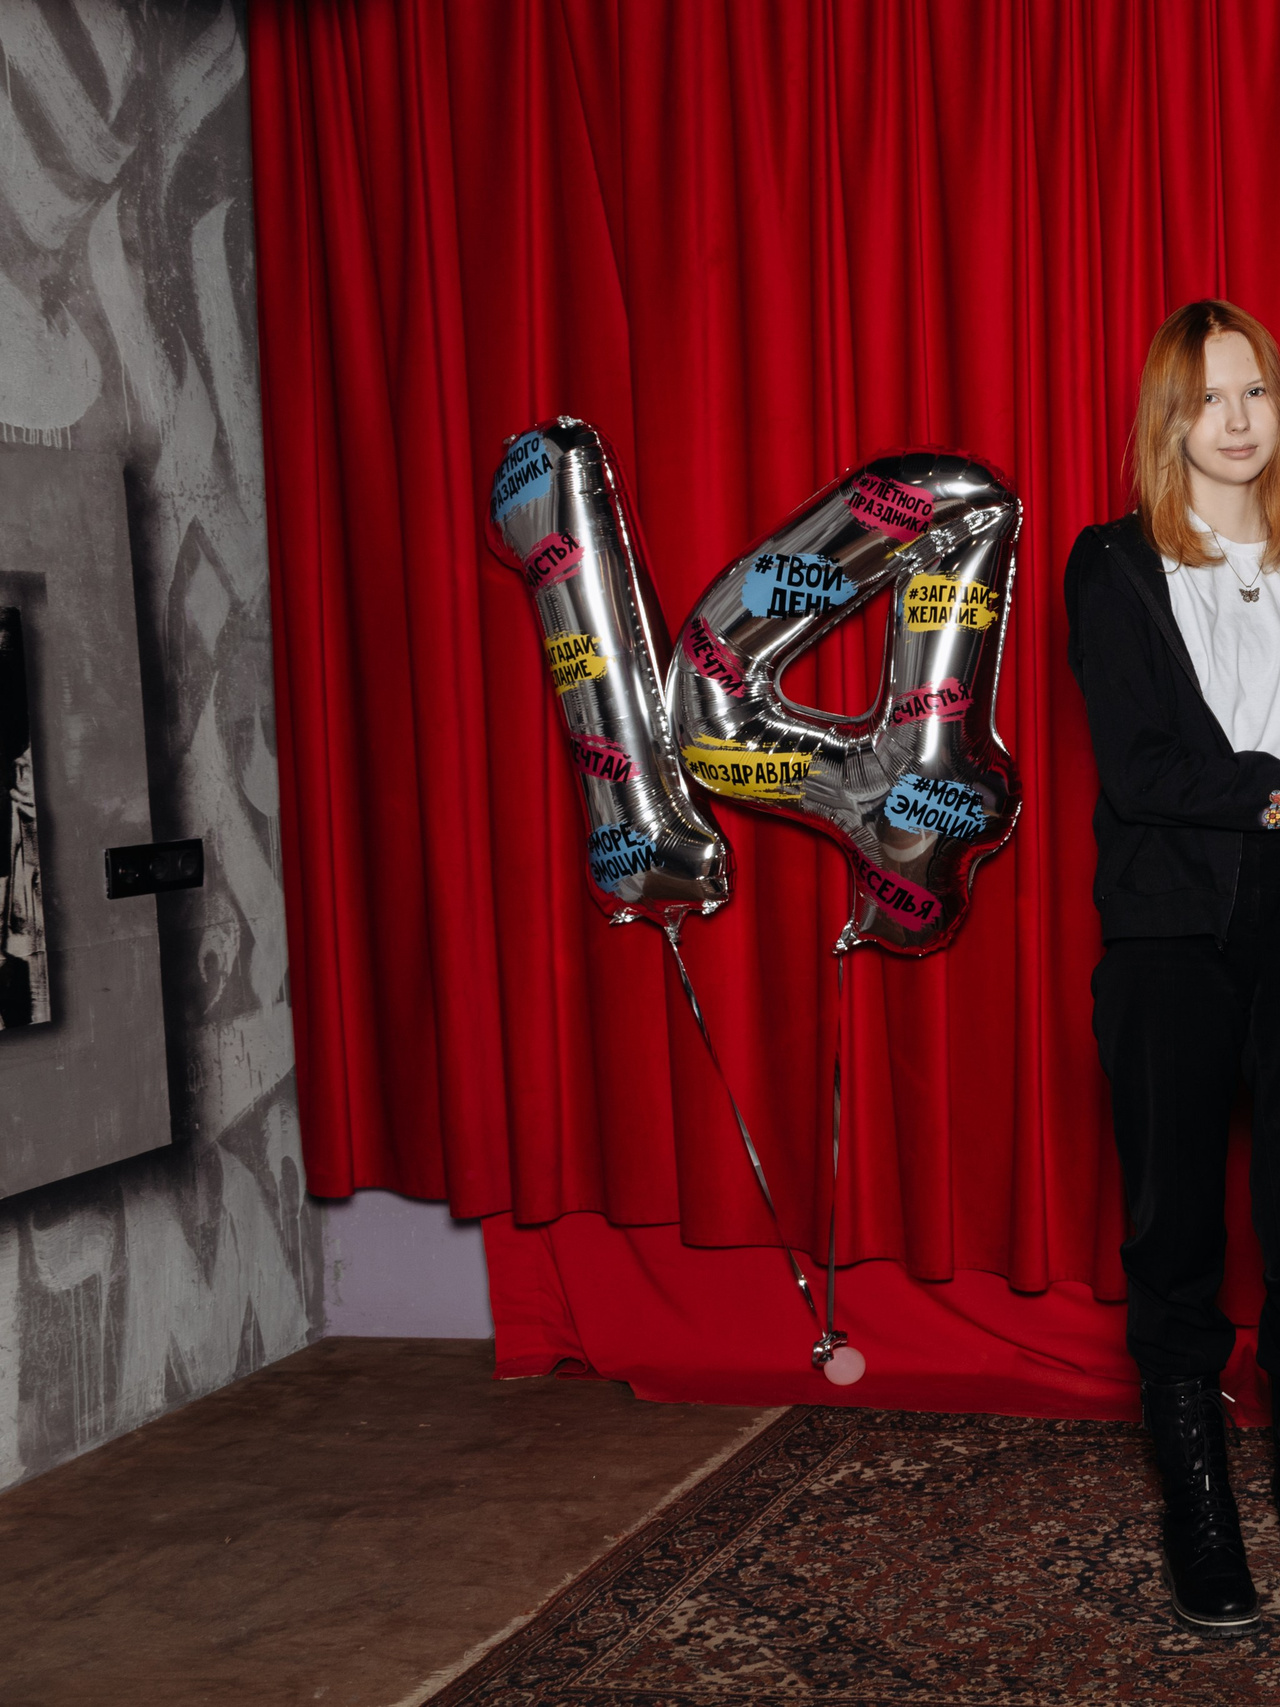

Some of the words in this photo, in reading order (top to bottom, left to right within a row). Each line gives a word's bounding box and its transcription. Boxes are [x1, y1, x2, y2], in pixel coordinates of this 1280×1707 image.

[495, 437, 540, 486] ЛЕТНОГО
[490, 453, 554, 518] РАЗДНИКА
[848, 491, 930, 533] ПРАЗДНИКА
[755, 553, 843, 591] #ТВОЙ
[767, 587, 837, 620] ДЕНЬ
[907, 606, 978, 625] ЖЕЛАНИЕ
[552, 659, 592, 687] ЛАНИЕ
[913, 777, 983, 819] #МОРЕ
[851, 850, 935, 920] ВЕСЕЛЬЯ
